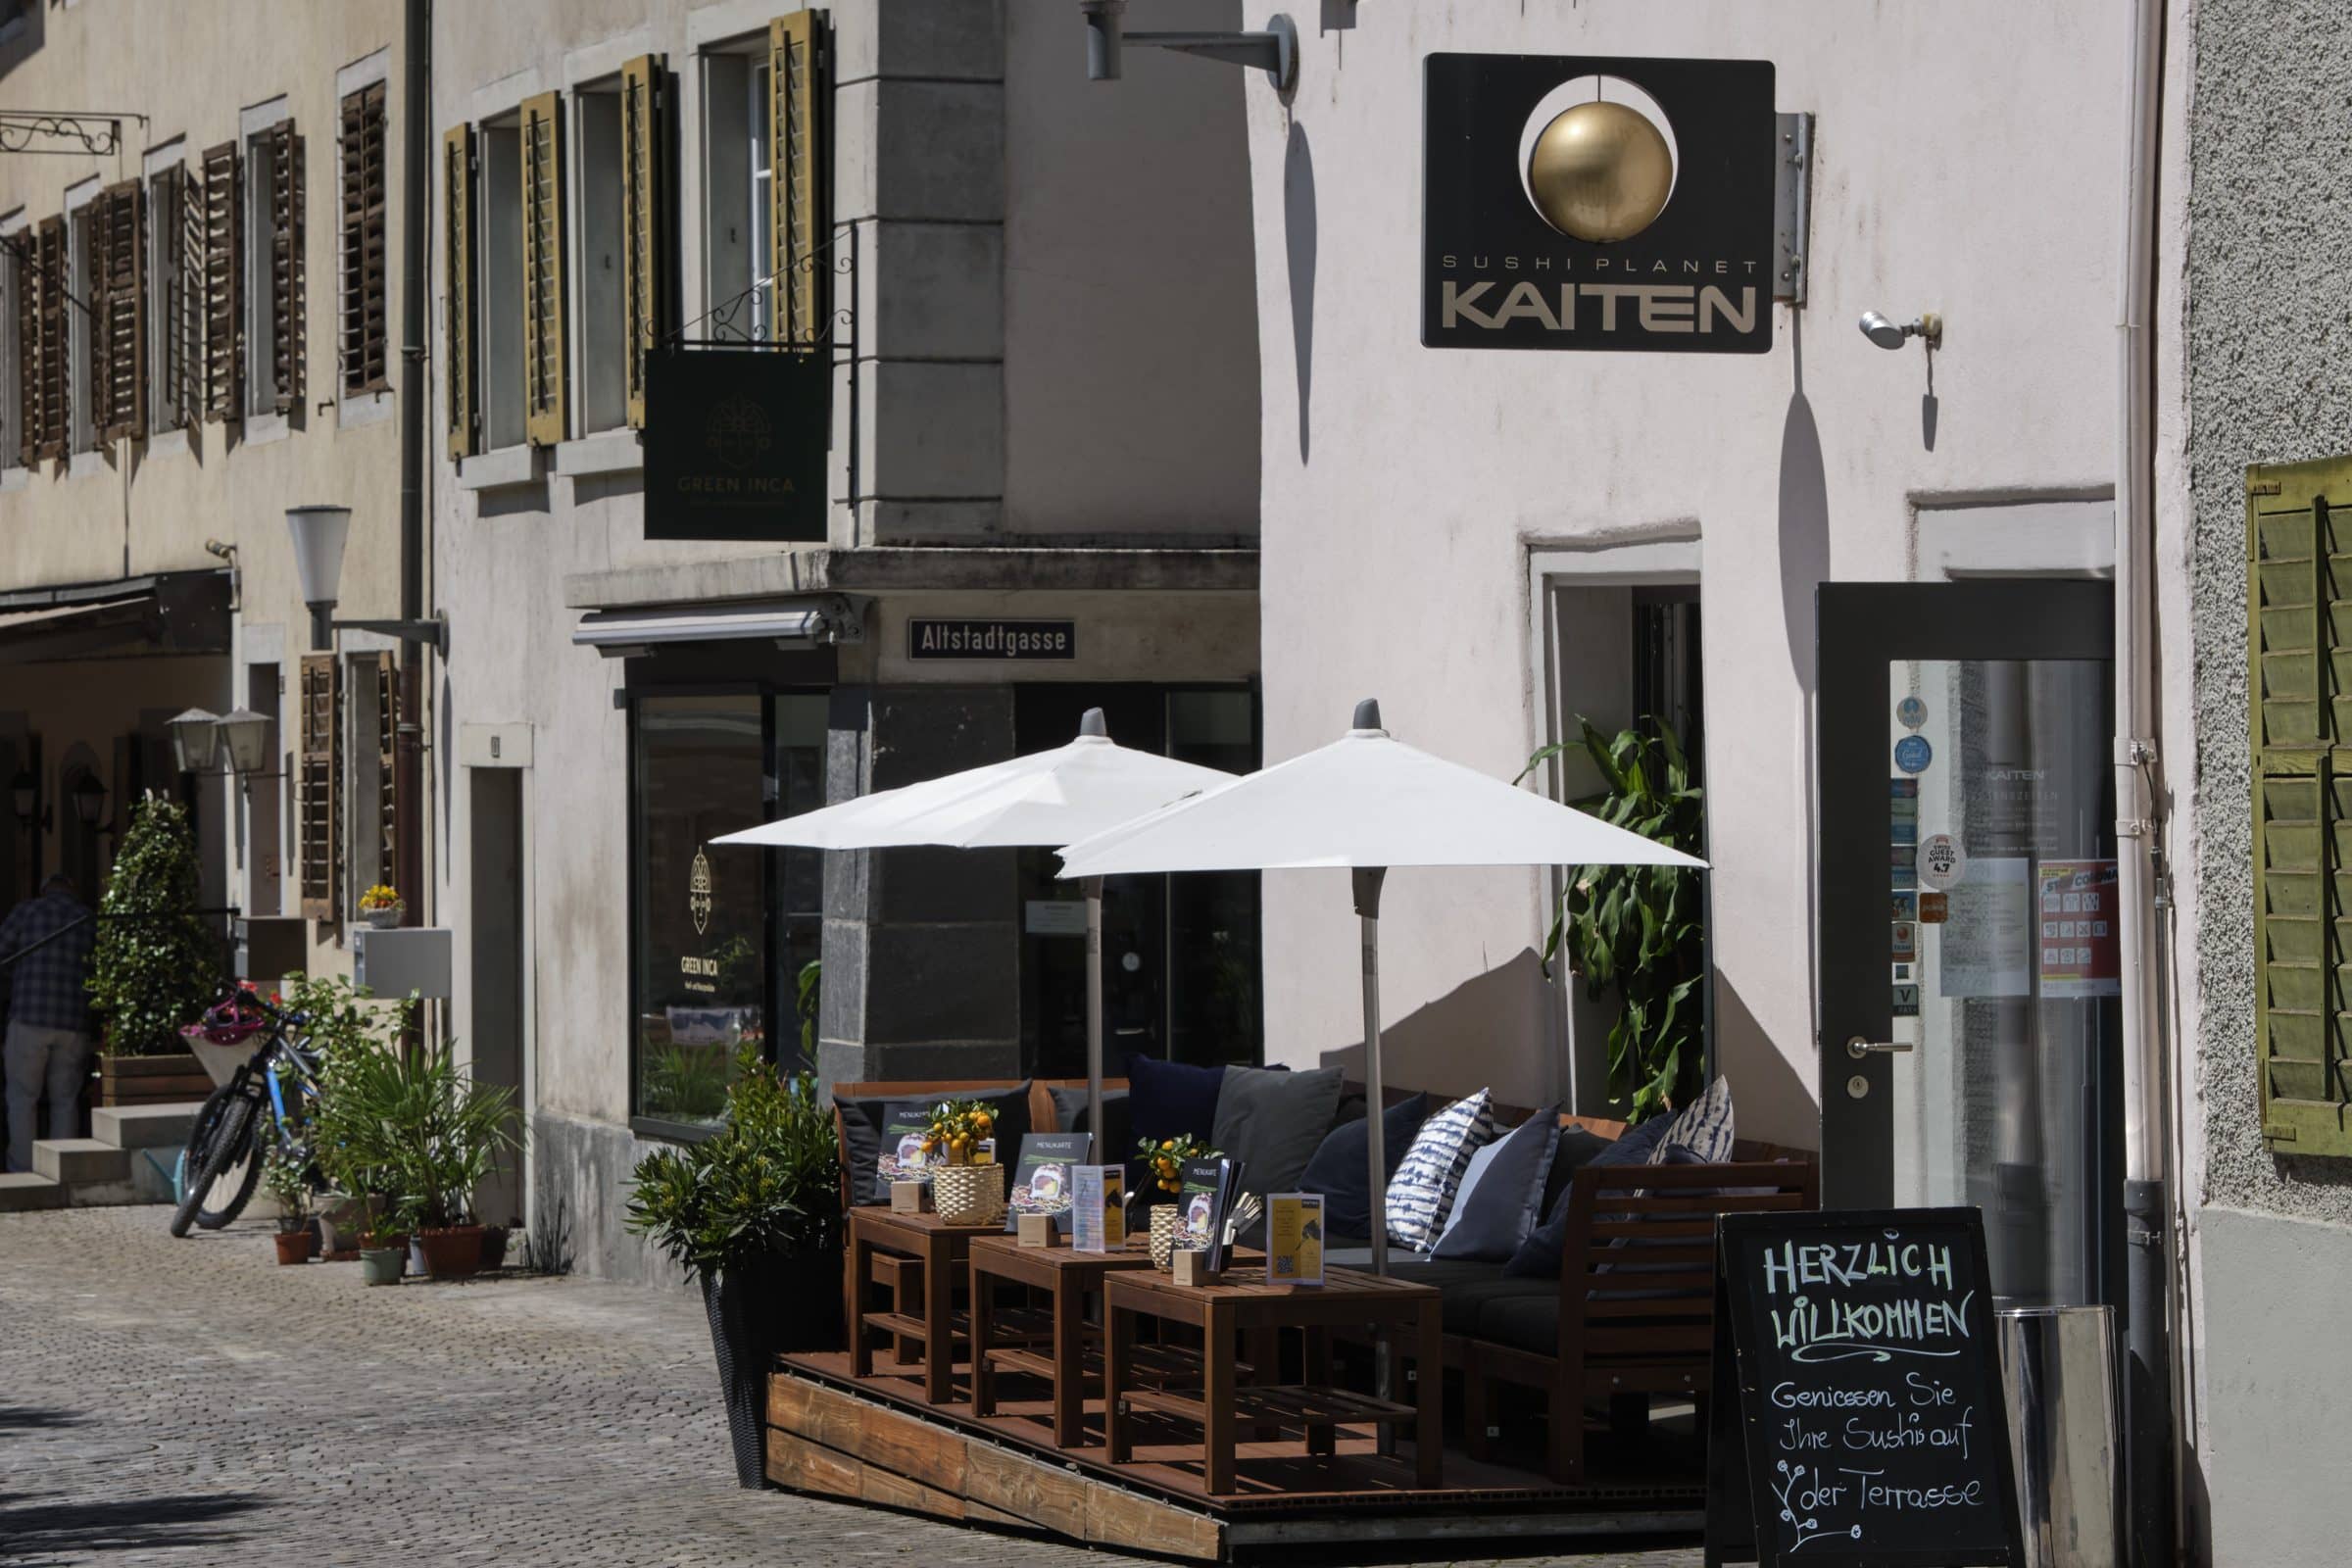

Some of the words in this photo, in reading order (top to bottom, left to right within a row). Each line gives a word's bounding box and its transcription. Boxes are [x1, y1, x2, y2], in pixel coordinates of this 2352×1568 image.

[1442, 280, 1756, 334] KAITEN
[677, 476, 740, 494] GREEN
[748, 477, 796, 494] INCA
[921, 624, 1066, 658] Altstadtgasse
[1934, 862, 1950, 873] 4.7
[681, 956, 702, 974] GREEN
[703, 958, 718, 976] INCA
[1764, 1229, 1953, 1295] HERZLICH
[1770, 1290, 1975, 1349] WILLKOMMEN
[1771, 1381, 1896, 1409] Geniessen
[1906, 1371, 1956, 1406] Sie
[1780, 1417, 1832, 1450] Ihre
[1930, 1404, 1973, 1460] auf
[1800, 1466, 1847, 1511] der
[1838, 1467, 1984, 1510] Terrasse
